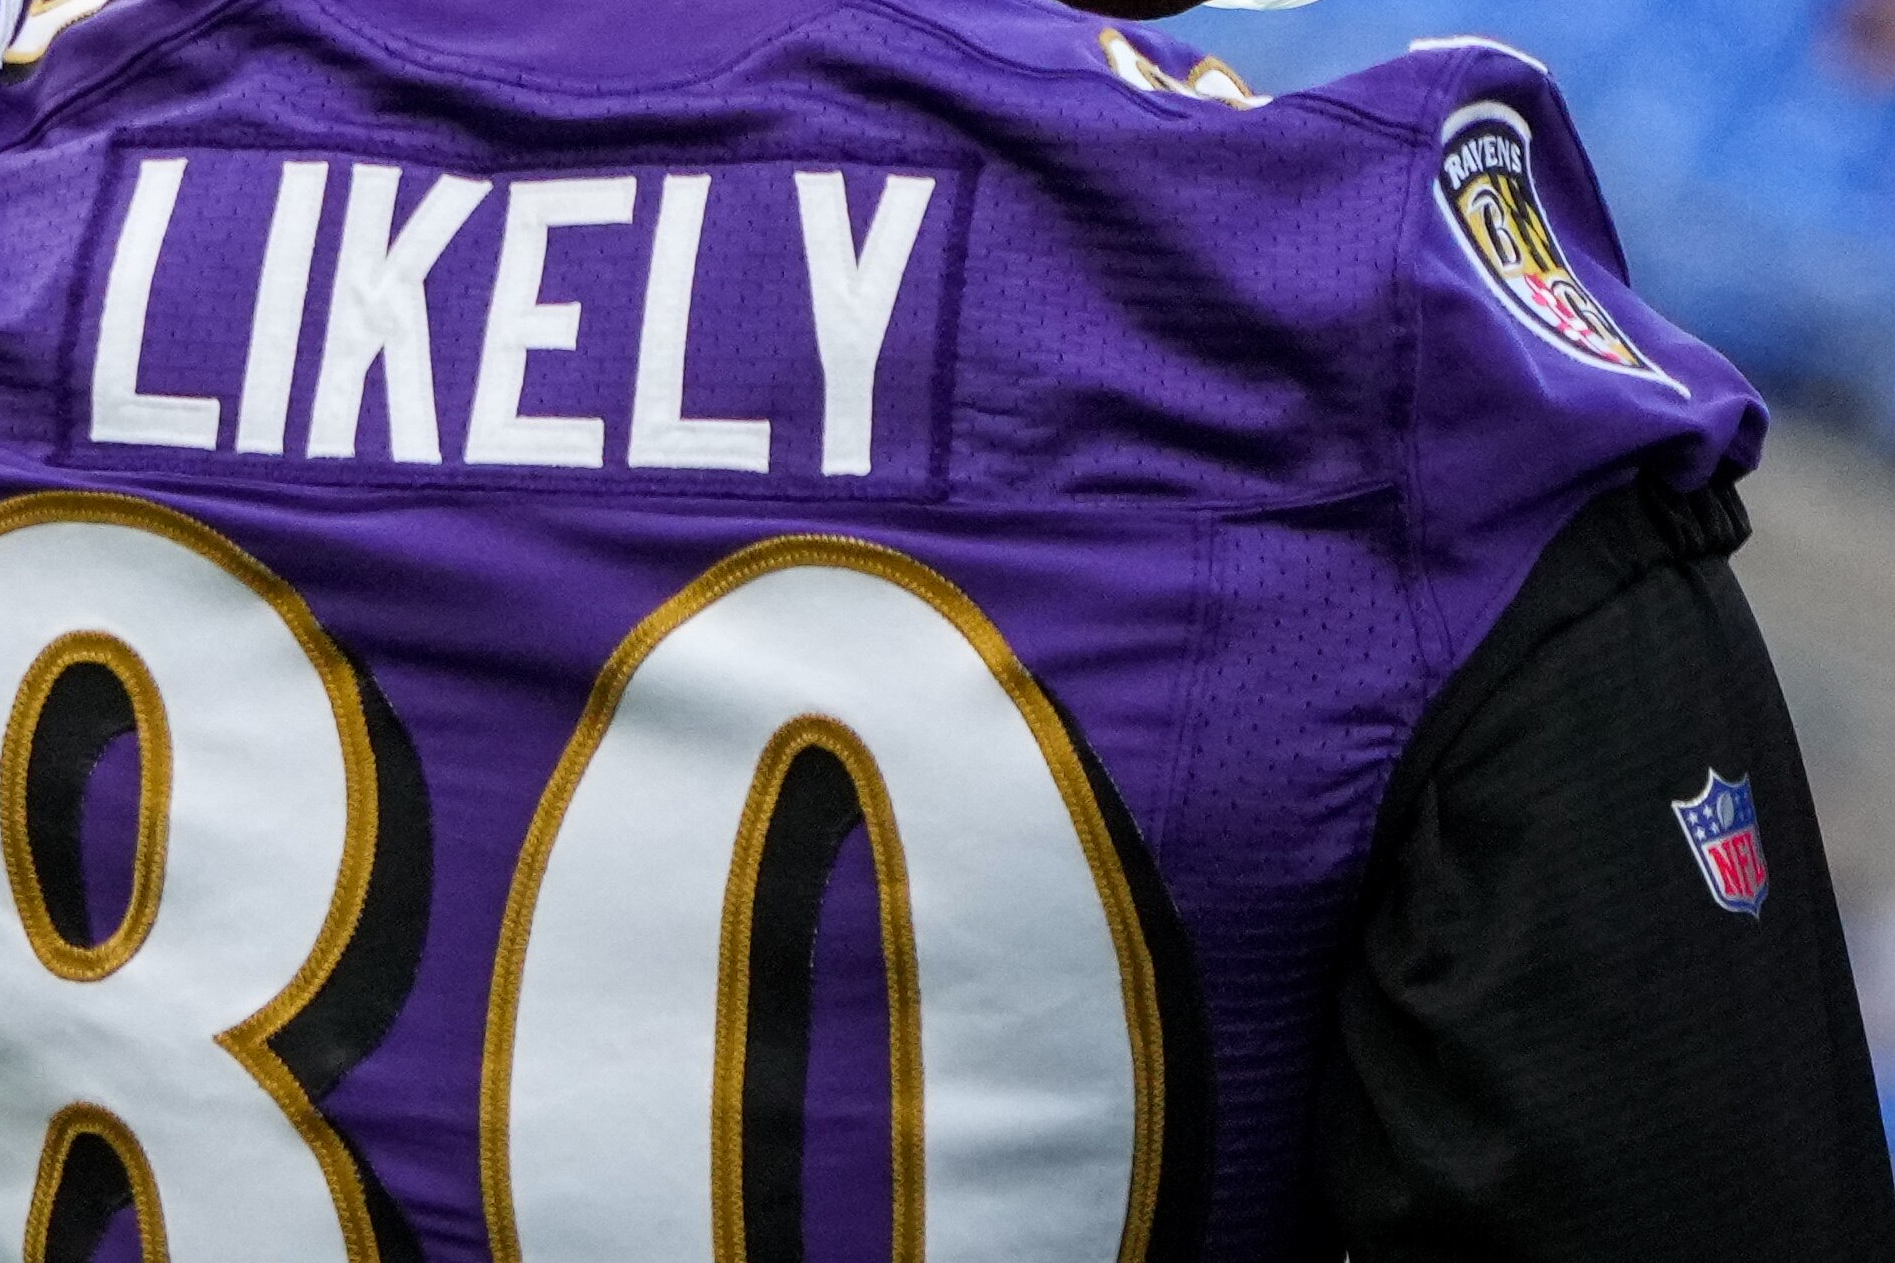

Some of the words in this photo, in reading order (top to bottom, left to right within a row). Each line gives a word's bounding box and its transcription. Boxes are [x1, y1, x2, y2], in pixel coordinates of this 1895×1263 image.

[1444, 136, 1522, 190] RAVENS
[90, 157, 936, 477] LIKELY
[1708, 831, 1767, 897] NFL
